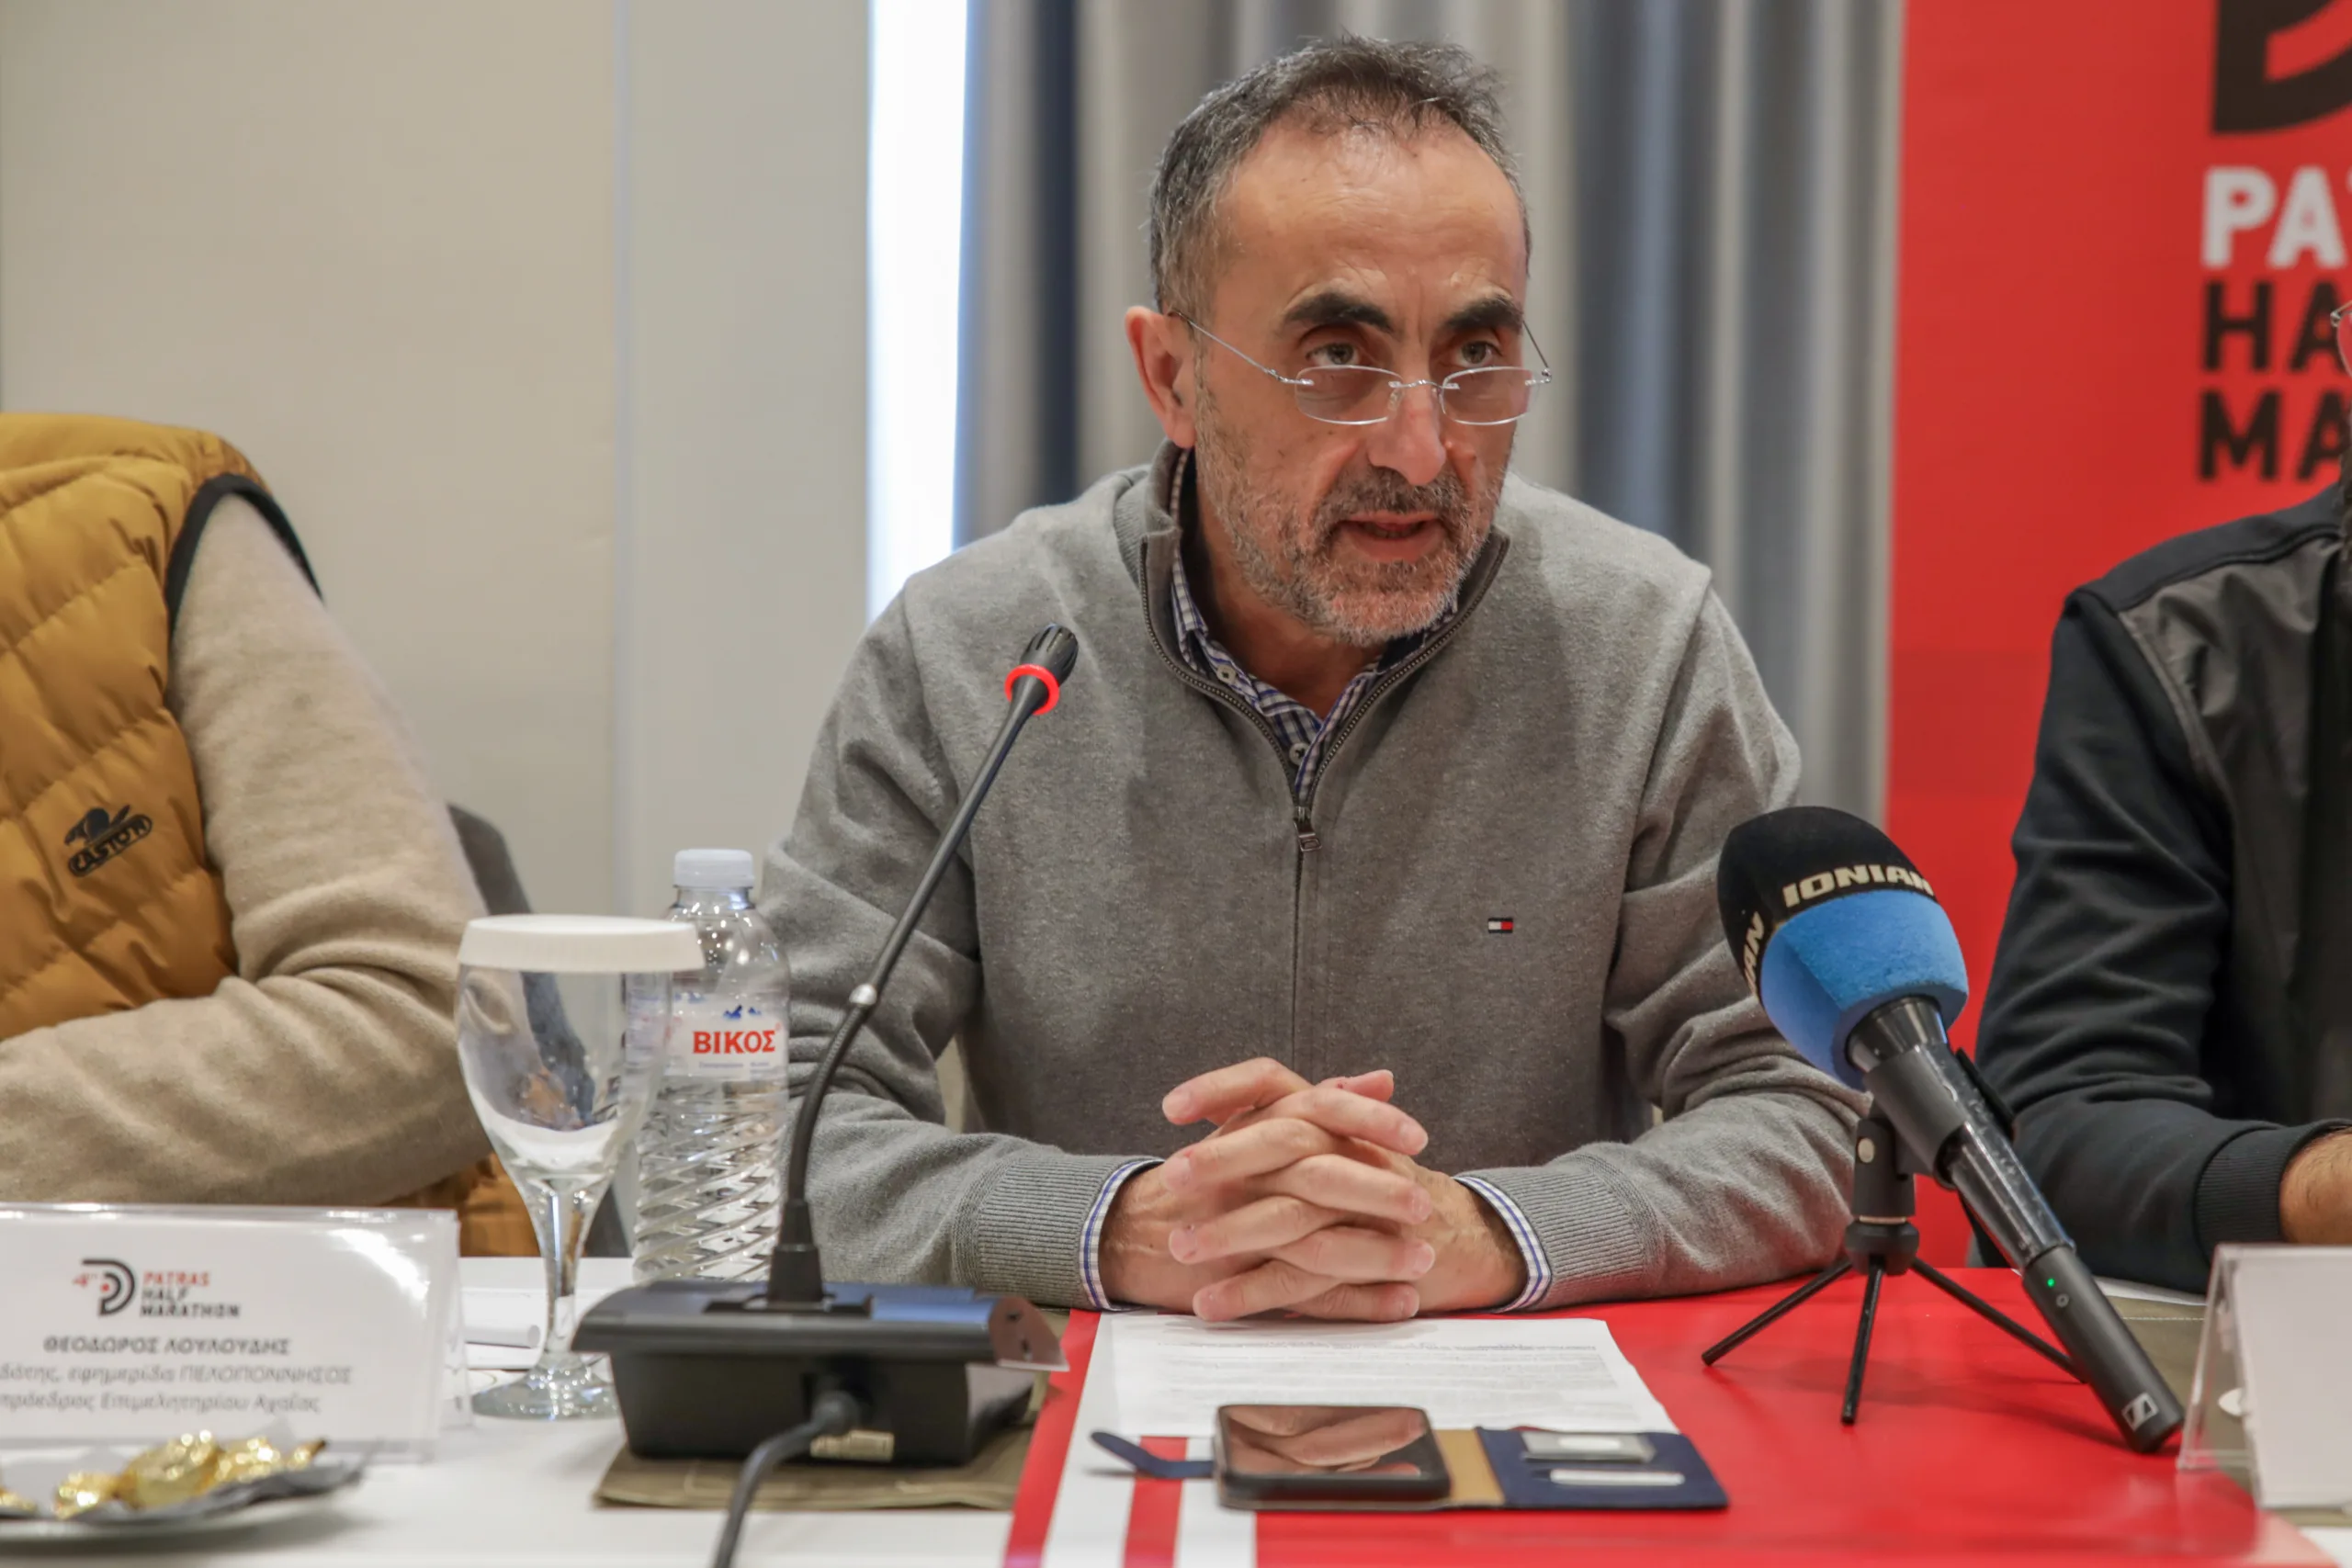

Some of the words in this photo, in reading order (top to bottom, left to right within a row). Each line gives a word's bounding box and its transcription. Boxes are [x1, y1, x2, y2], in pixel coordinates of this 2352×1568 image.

[2202, 166, 2352, 268] PA
[693, 1030, 776, 1055] ΒΙΚΟΣ
[143, 1271, 210, 1287] PATRAS
[141, 1289, 187, 1302] HALF
[141, 1303, 241, 1318] MARATHON
[43, 1337, 159, 1355] ΘΕΟΔΩΡΟΣ
[164, 1337, 291, 1356] ΛΟΥΛΟΥΔΗΣ
